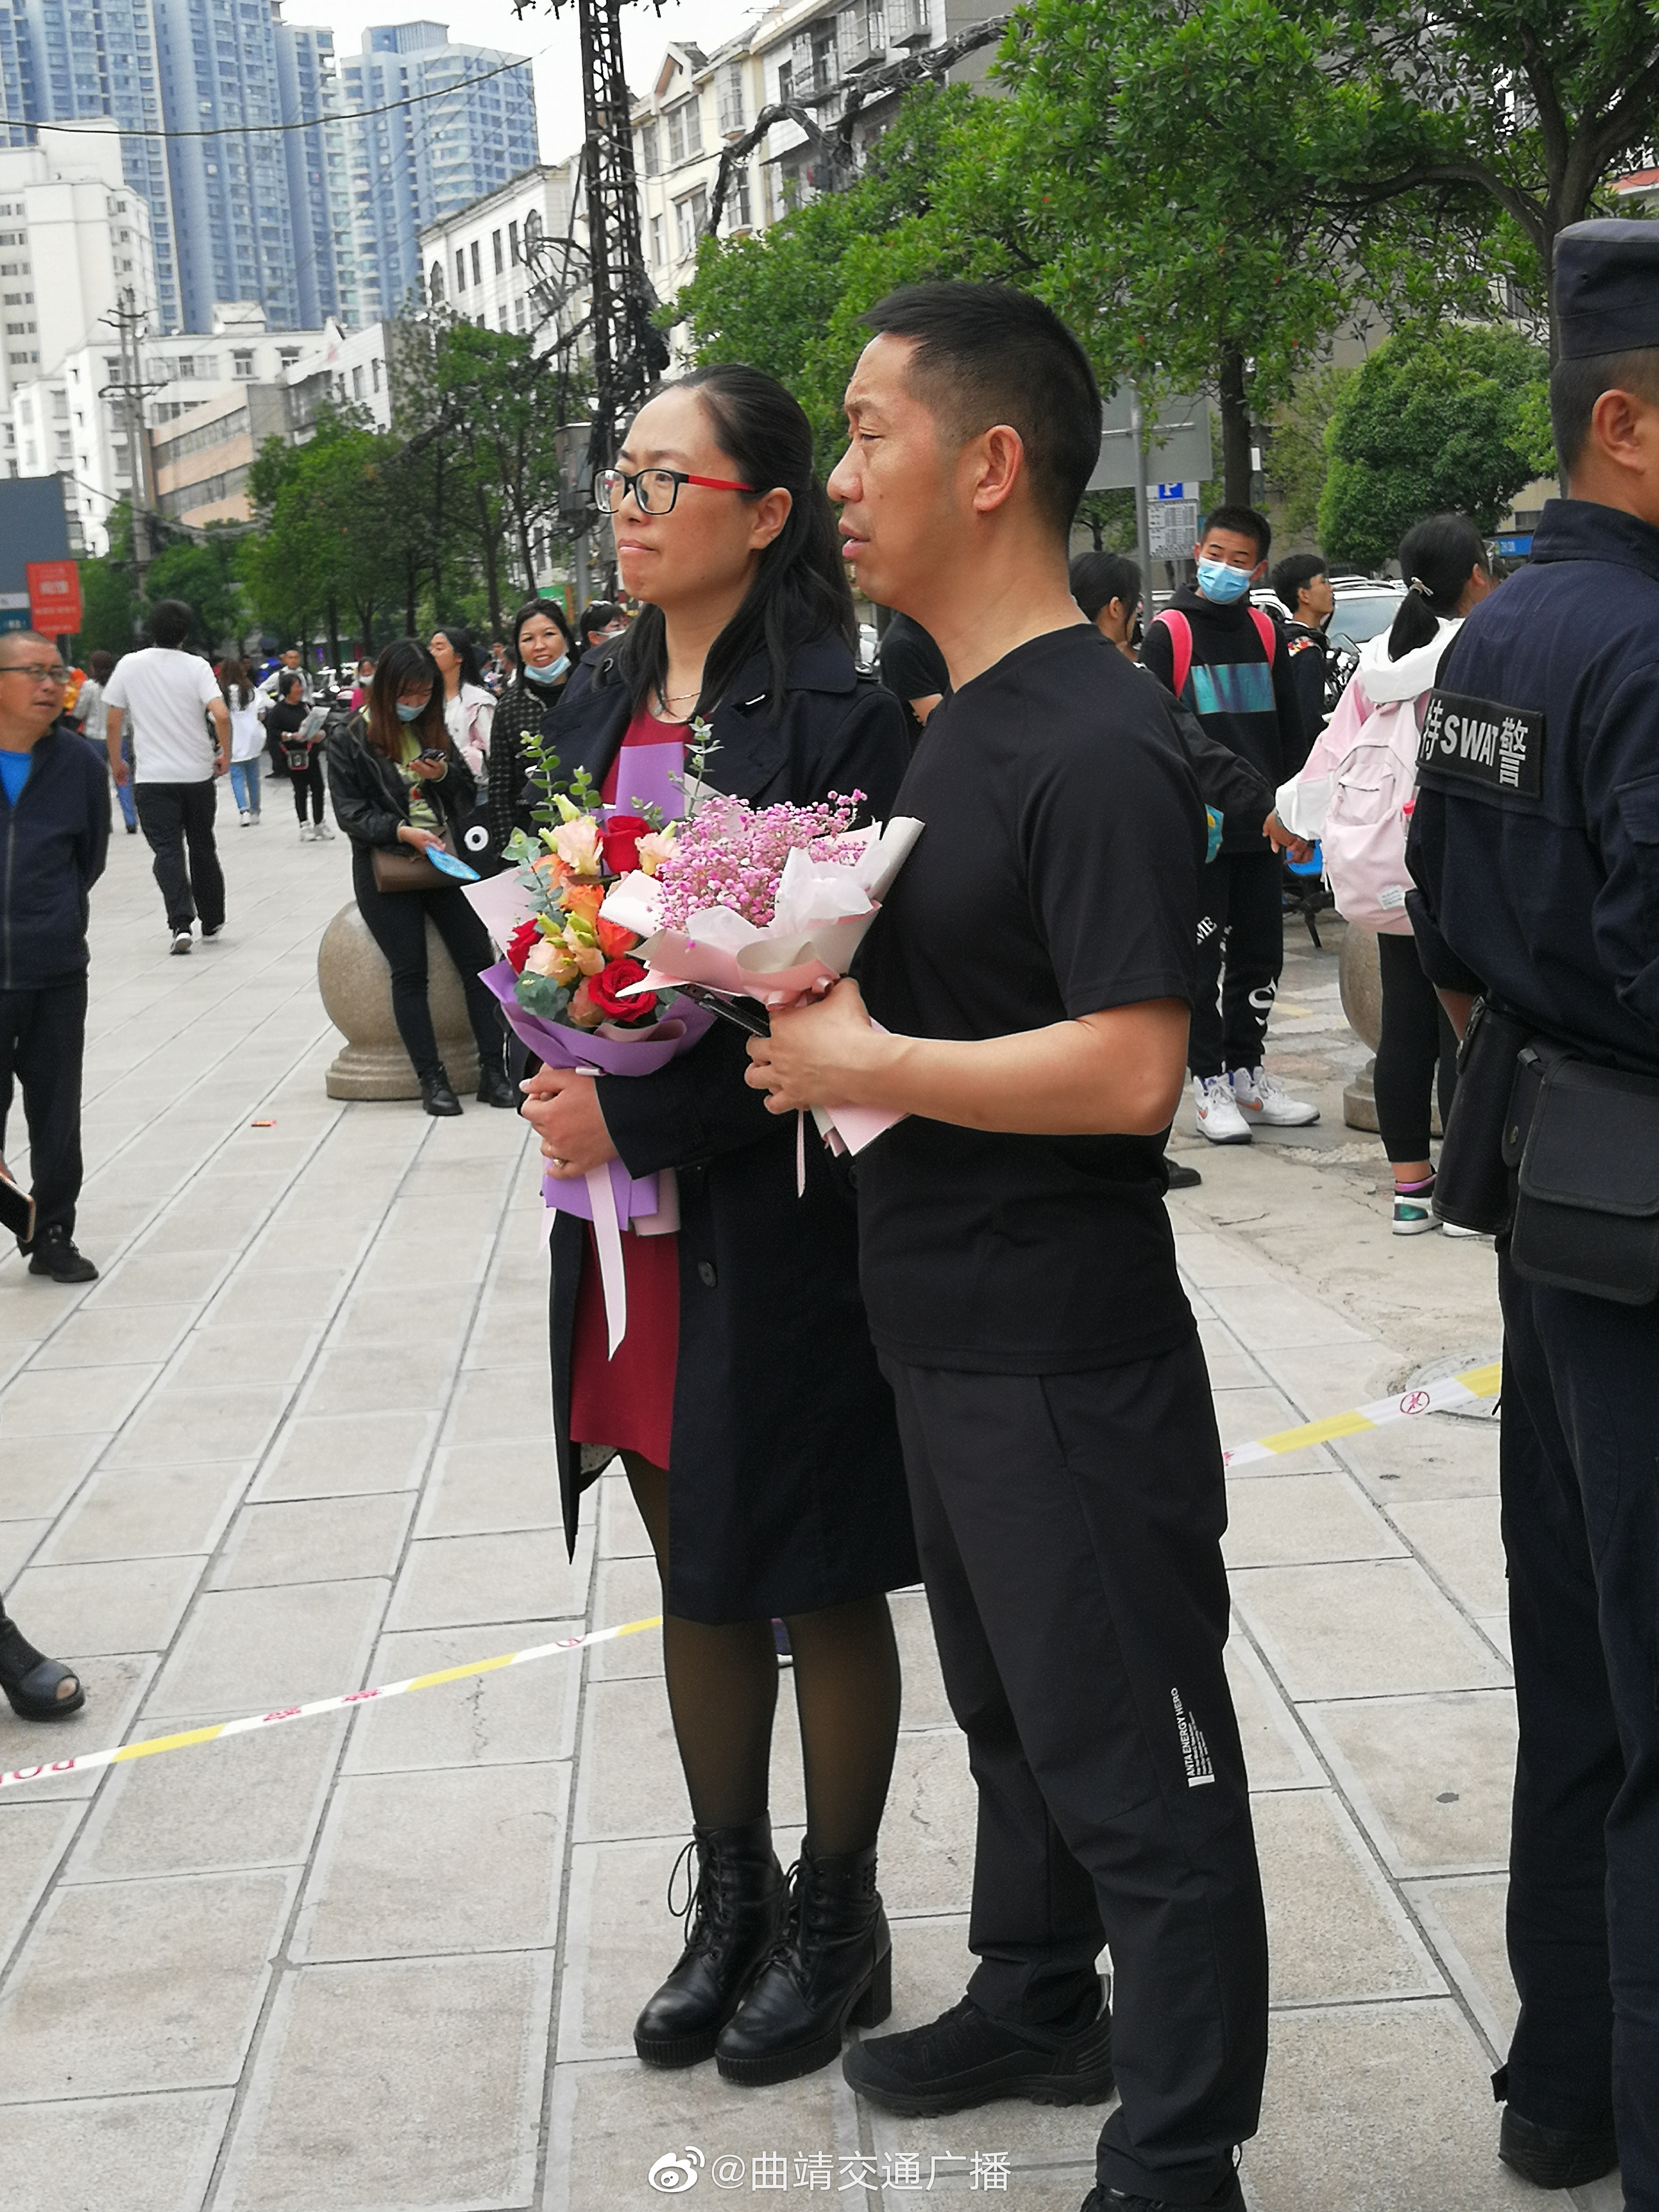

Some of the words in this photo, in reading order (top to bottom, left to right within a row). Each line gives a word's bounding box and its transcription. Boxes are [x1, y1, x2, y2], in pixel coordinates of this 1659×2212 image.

[1171, 1687, 1184, 1716] HERO
[1177, 1717, 1191, 1754] ENERGY
[1184, 1754, 1195, 1776] ANTA
